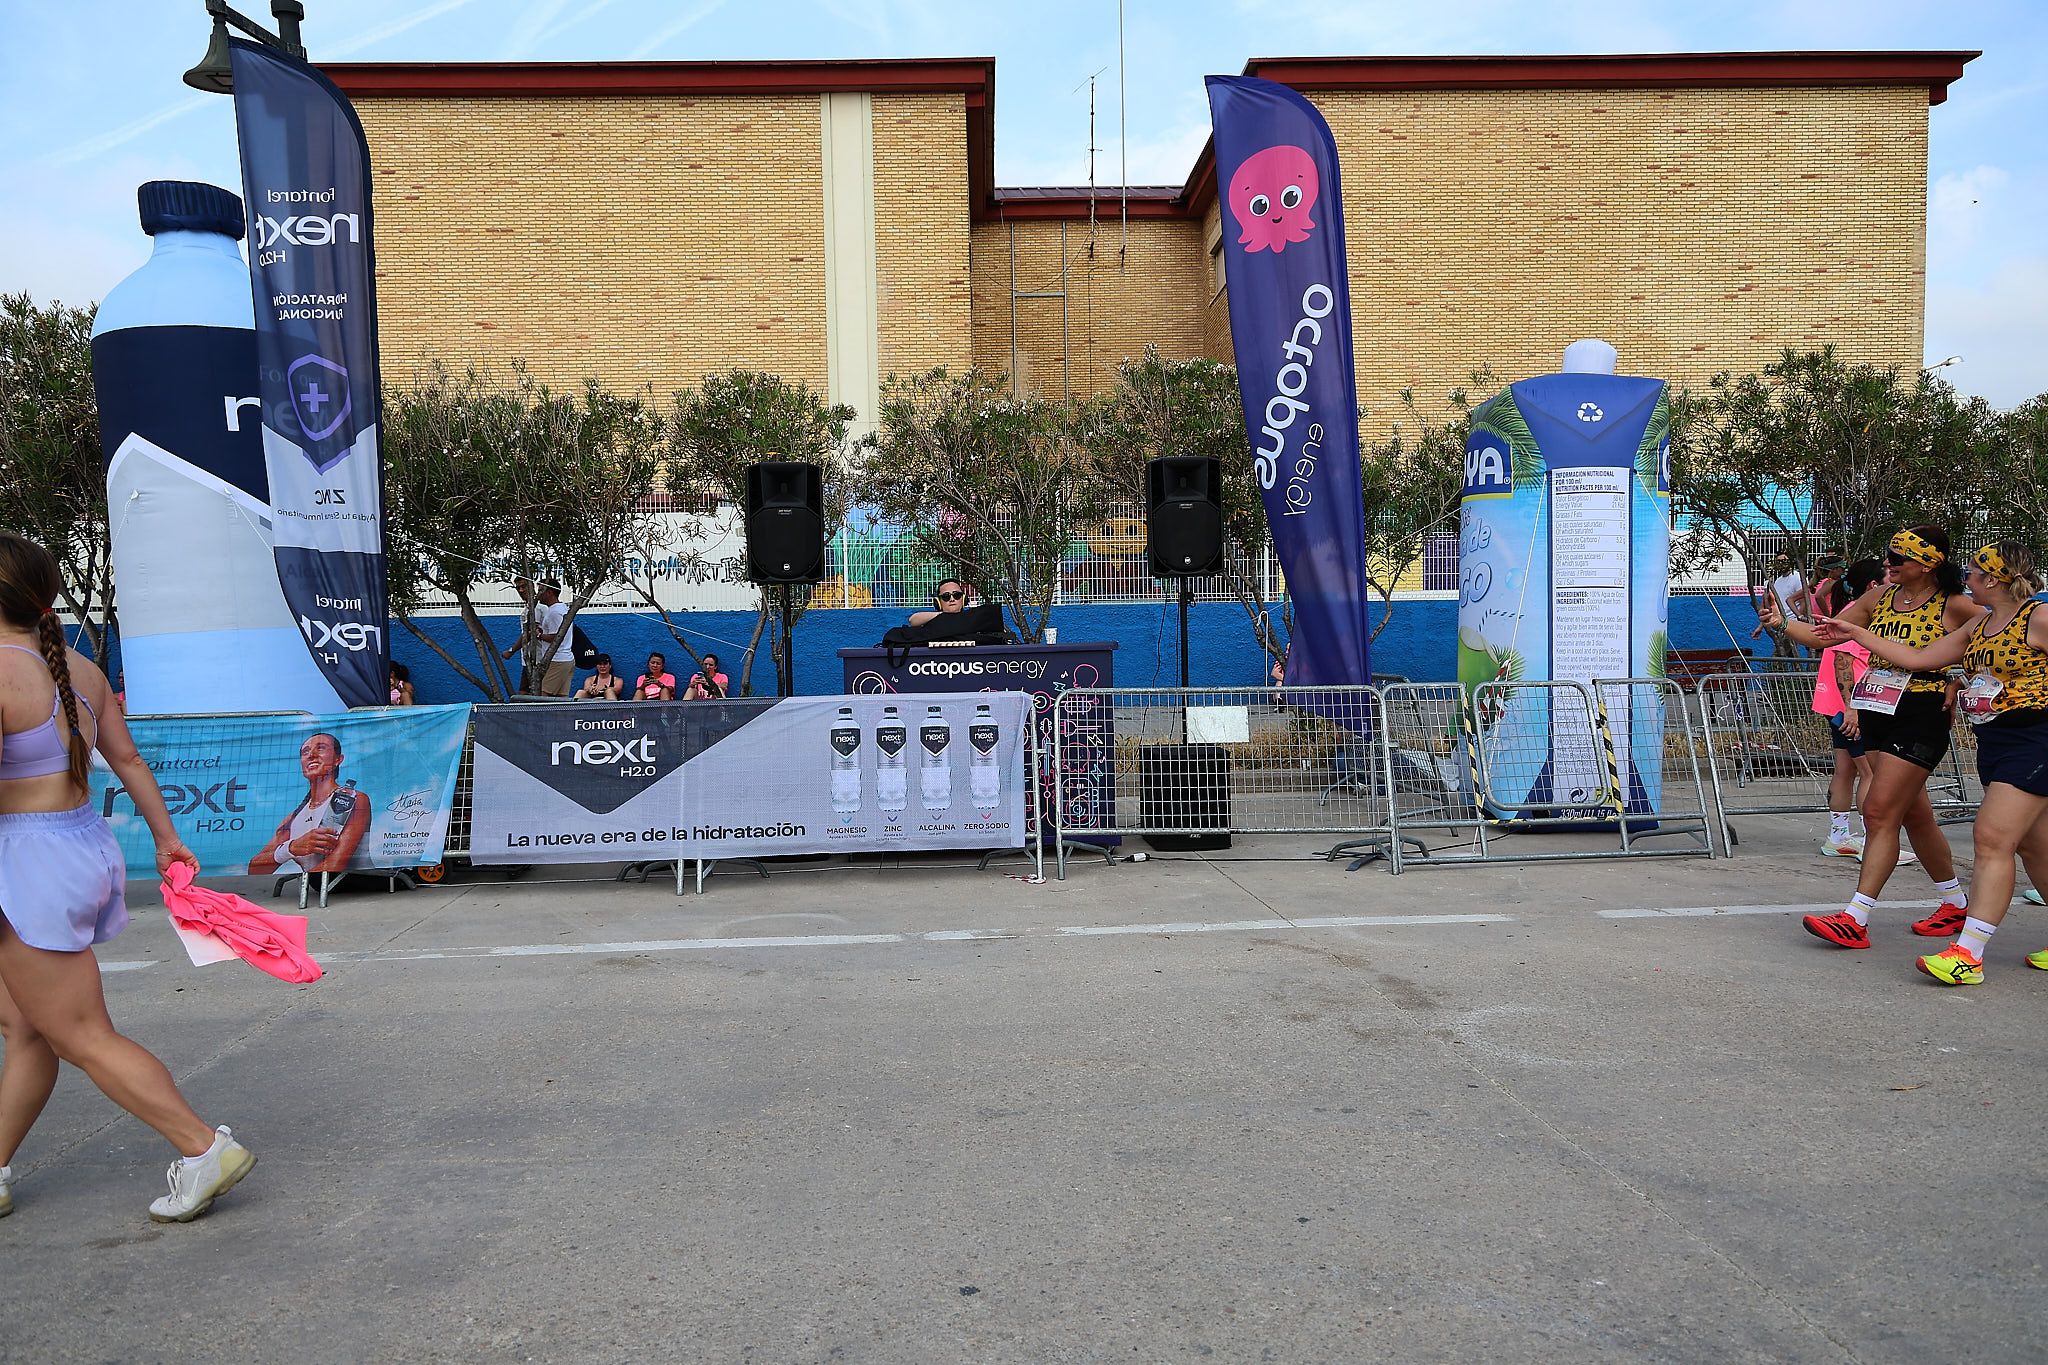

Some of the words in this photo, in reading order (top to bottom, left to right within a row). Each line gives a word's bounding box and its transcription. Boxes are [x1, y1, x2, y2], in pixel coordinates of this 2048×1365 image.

[1463, 446, 1504, 488] YA
[908, 660, 984, 678] octopus
[985, 660, 1048, 679] energy
[574, 717, 635, 730] Fontarel
[881, 734, 901, 742] next
[974, 732, 994, 740] next
[551, 734, 656, 766] next
[146, 755, 221, 771] ontarel
[620, 765, 656, 778] H2.0
[196, 818, 245, 833] H2.0
[826, 826, 868, 834] MAGNESIO
[918, 824, 956, 832] ALCALINA
[986, 822, 1010, 830] SODIO
[383, 832, 409, 840] Marta
[507, 832, 530, 848] La
[534, 832, 595, 846] nueva
[600, 830, 636, 844] era
[641, 827, 668, 842] de
[671, 826, 688, 842] la
[692, 821, 806, 840] hidratación
